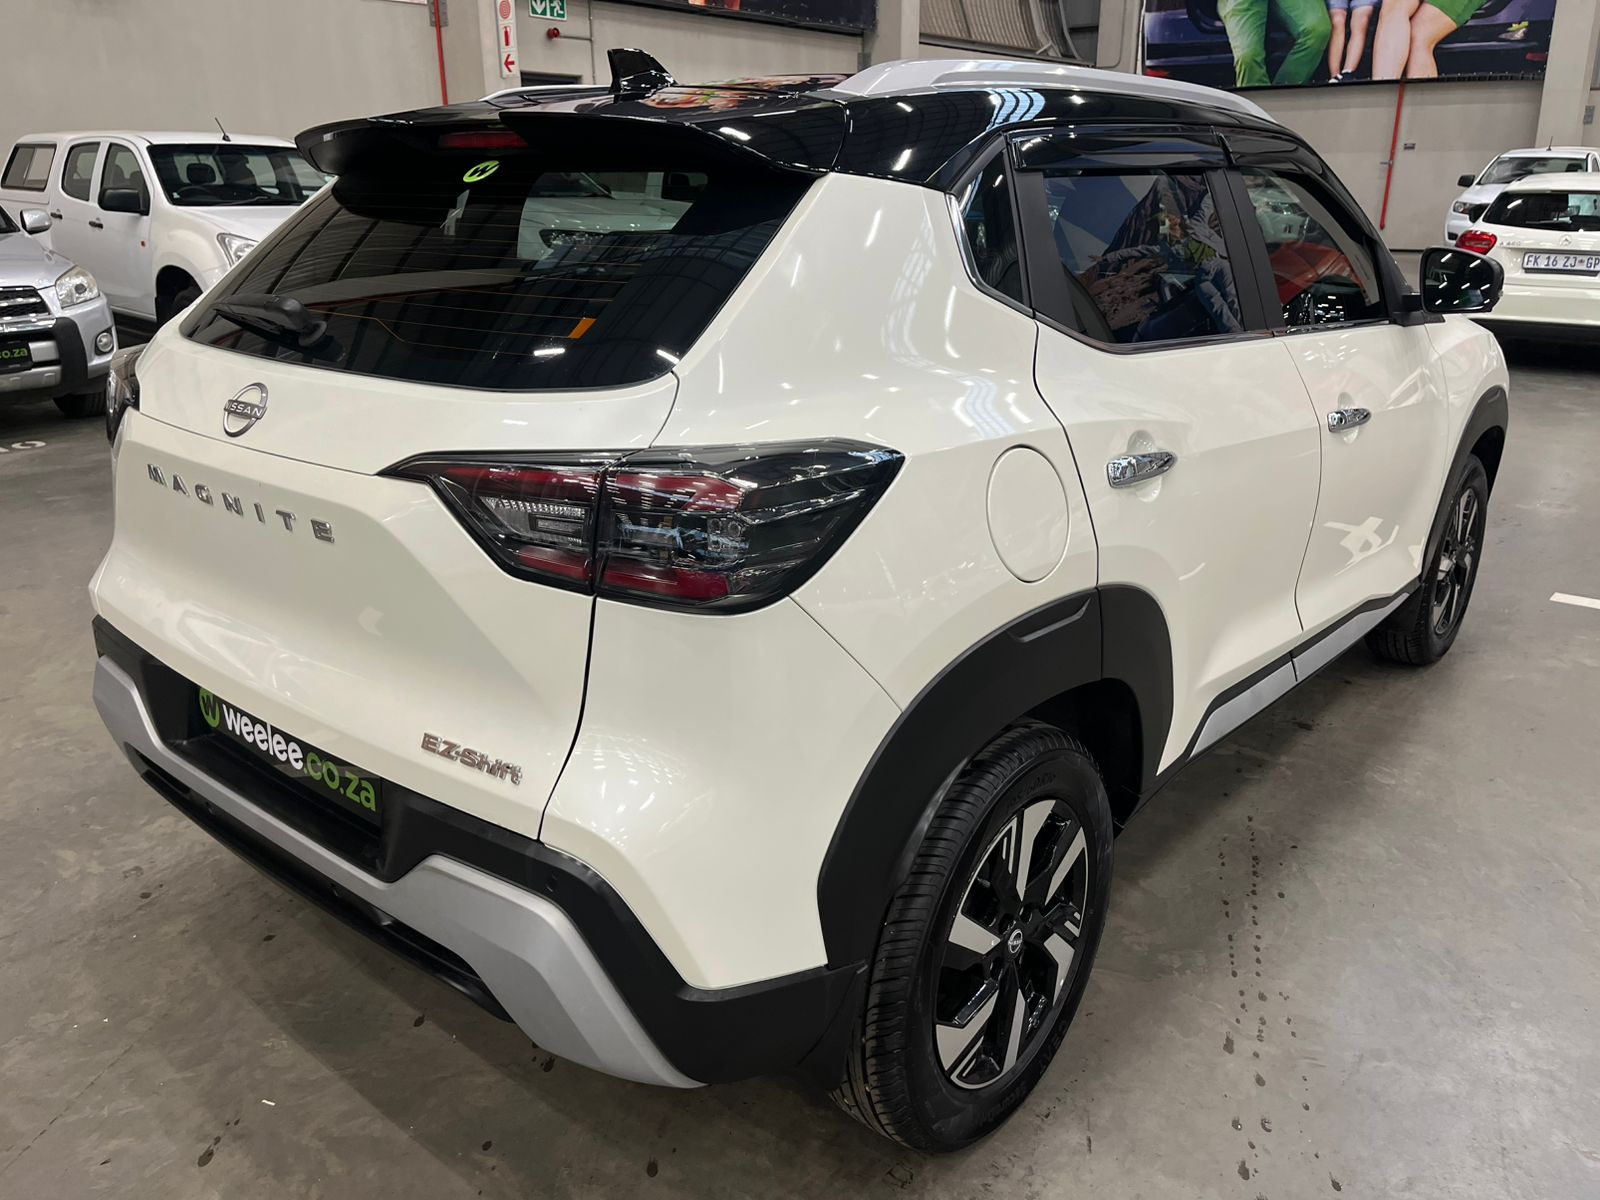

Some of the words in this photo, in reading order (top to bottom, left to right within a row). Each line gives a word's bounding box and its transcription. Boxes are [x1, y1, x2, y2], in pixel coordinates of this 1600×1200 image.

[1526, 254, 1541, 267] FK
[1544, 255, 1558, 267] 16
[1562, 256, 1577, 268] ZJ
[1585, 256, 1600, 269] GP
[147, 464, 335, 543] MAGNITE
[222, 703, 376, 812] weelee.co.za
[420, 733, 523, 786] EZ-Shift
